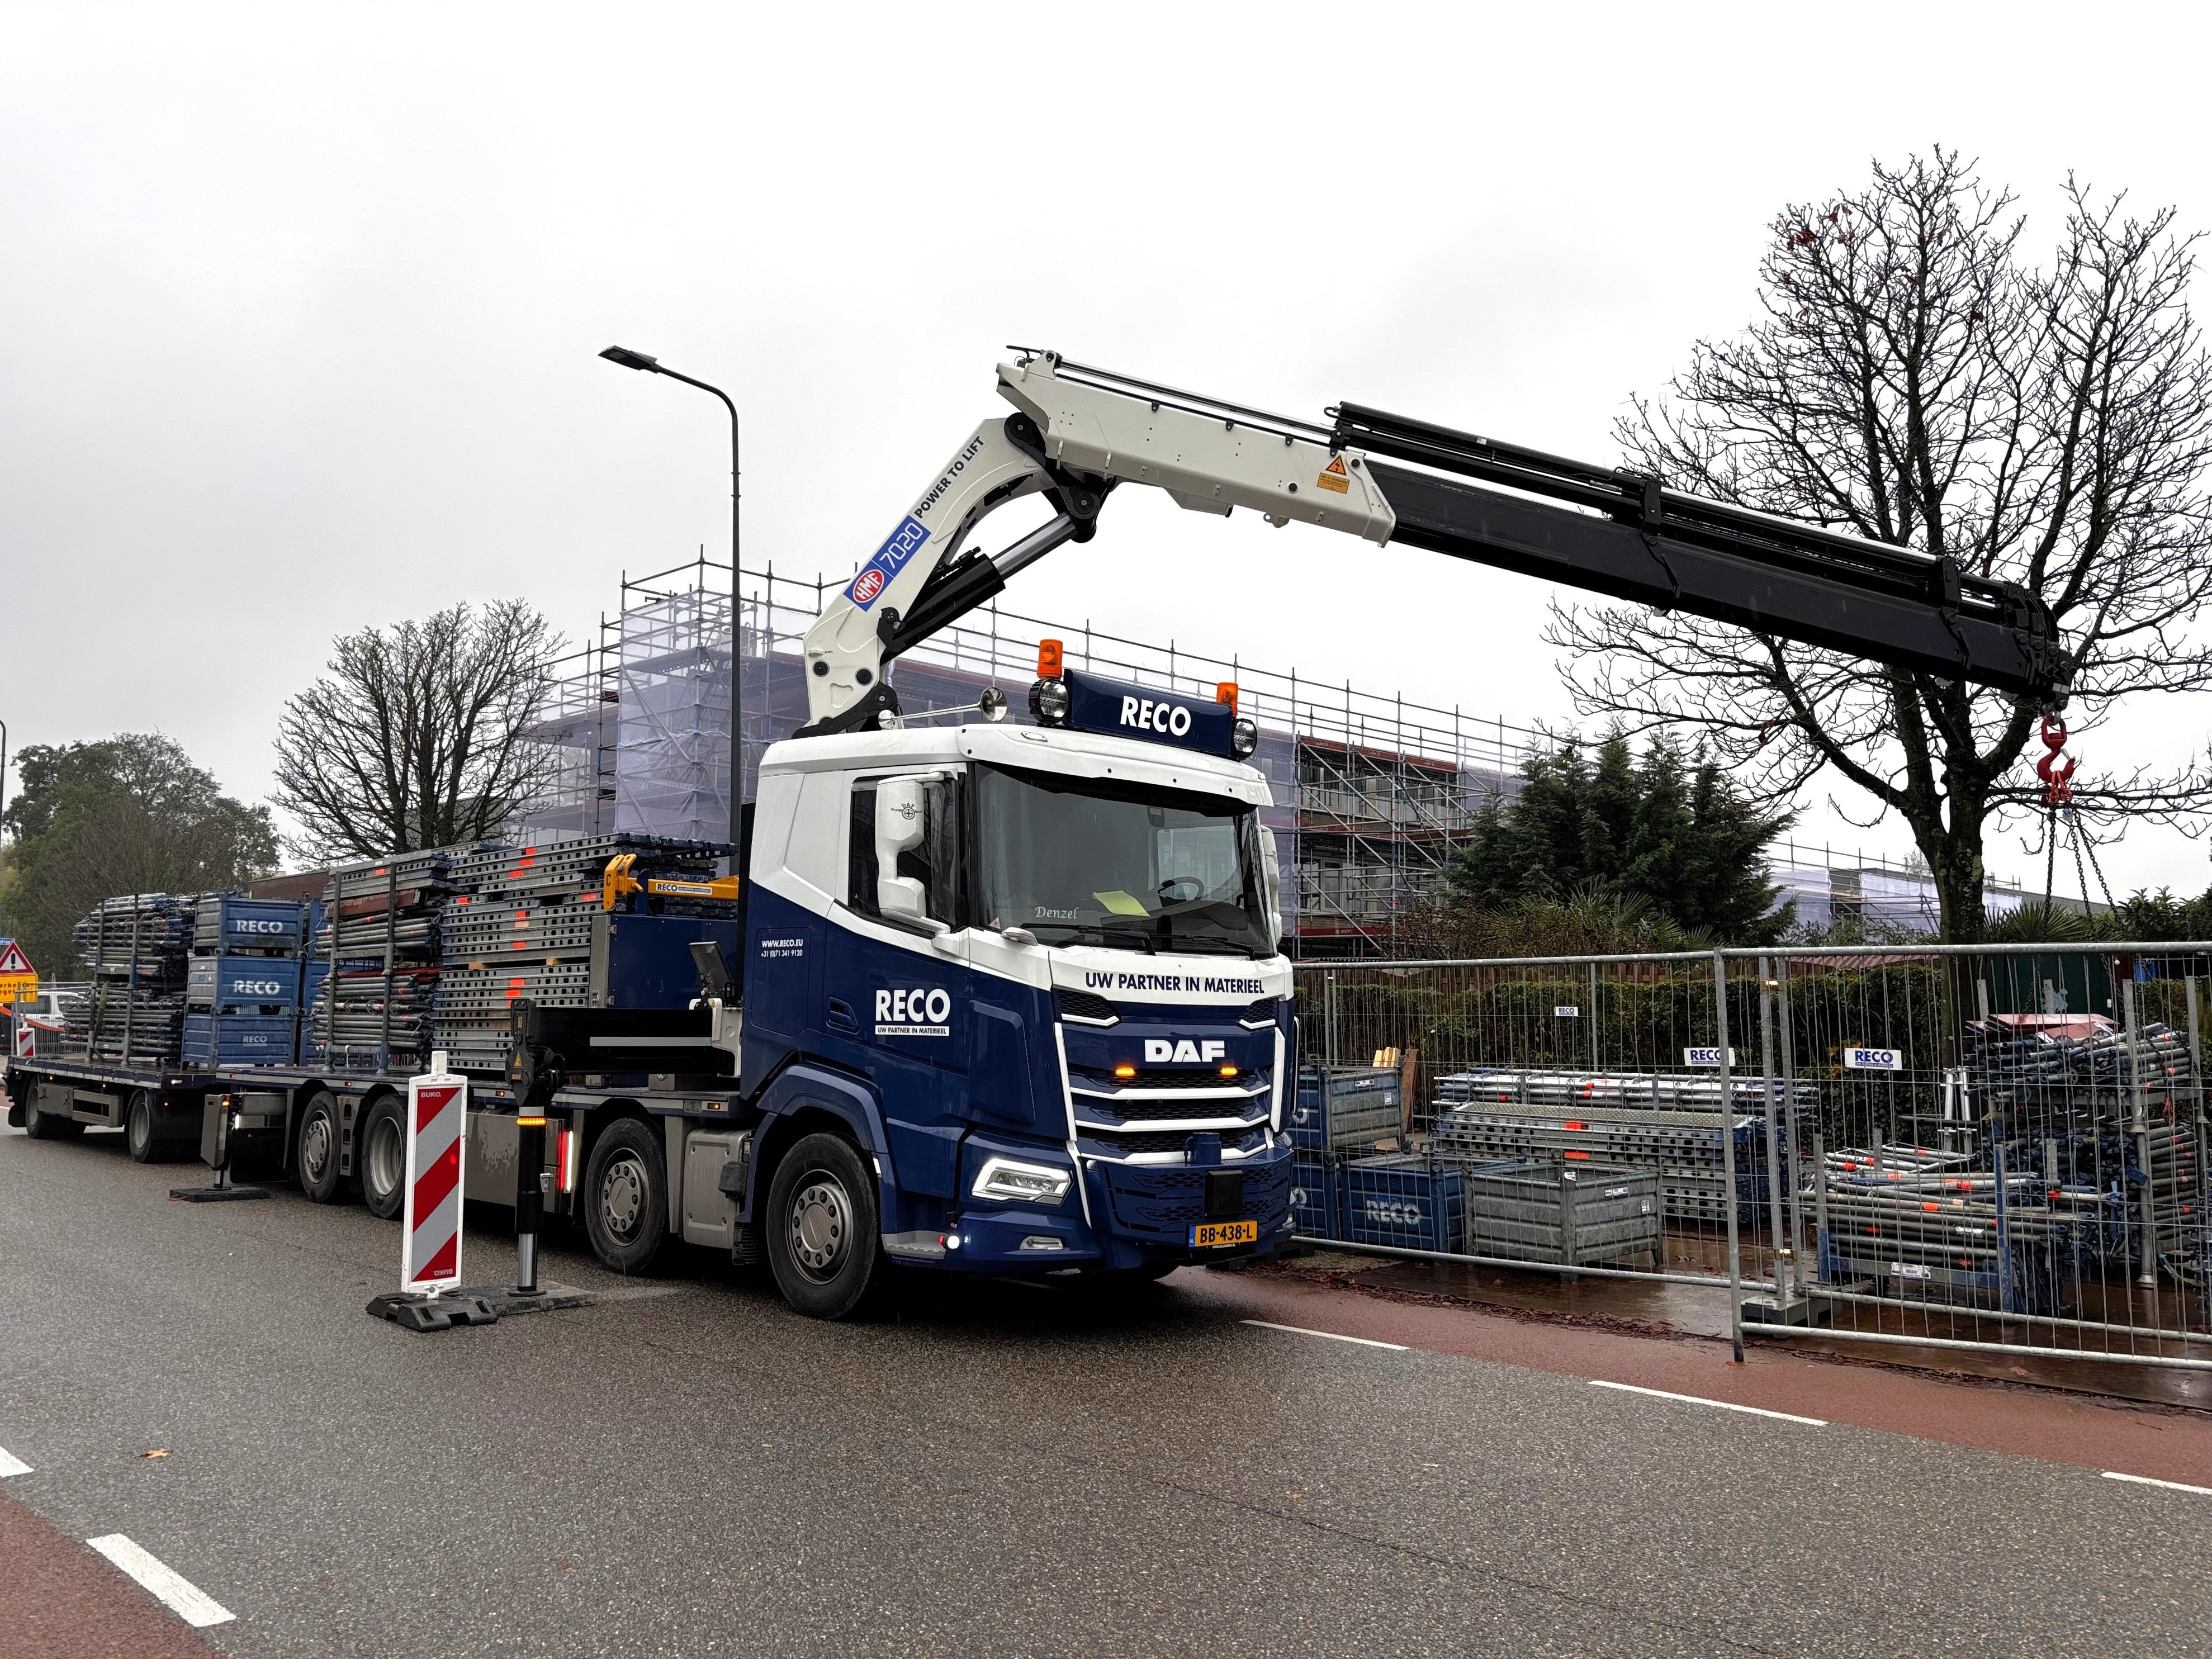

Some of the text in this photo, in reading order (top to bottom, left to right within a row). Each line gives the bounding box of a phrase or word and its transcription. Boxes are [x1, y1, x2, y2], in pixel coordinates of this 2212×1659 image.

[914, 435, 984, 519] POWER TO LIFT
[879, 522, 923, 569] 7020
[856, 572, 880, 600] HMF
[1120, 695, 1191, 736] RECO
[657, 883, 677, 892] RECO
[1035, 906, 1079, 919] Denzel
[236, 919, 283, 933] RECO
[761, 938, 803, 948] WWW.RECO.EU
[770, 950, 780, 959] (0)71
[233, 980, 280, 995] RECO
[1085, 971, 1264, 994] UW PARTNER IN MATERIEEL
[875, 988, 950, 1023] RECO
[1144, 1039, 1225, 1062] DAF
[1855, 1050, 1893, 1063] RECO
[1366, 1200, 1420, 1225] RECO
[1200, 1224, 1253, 1243] BB-438-L
